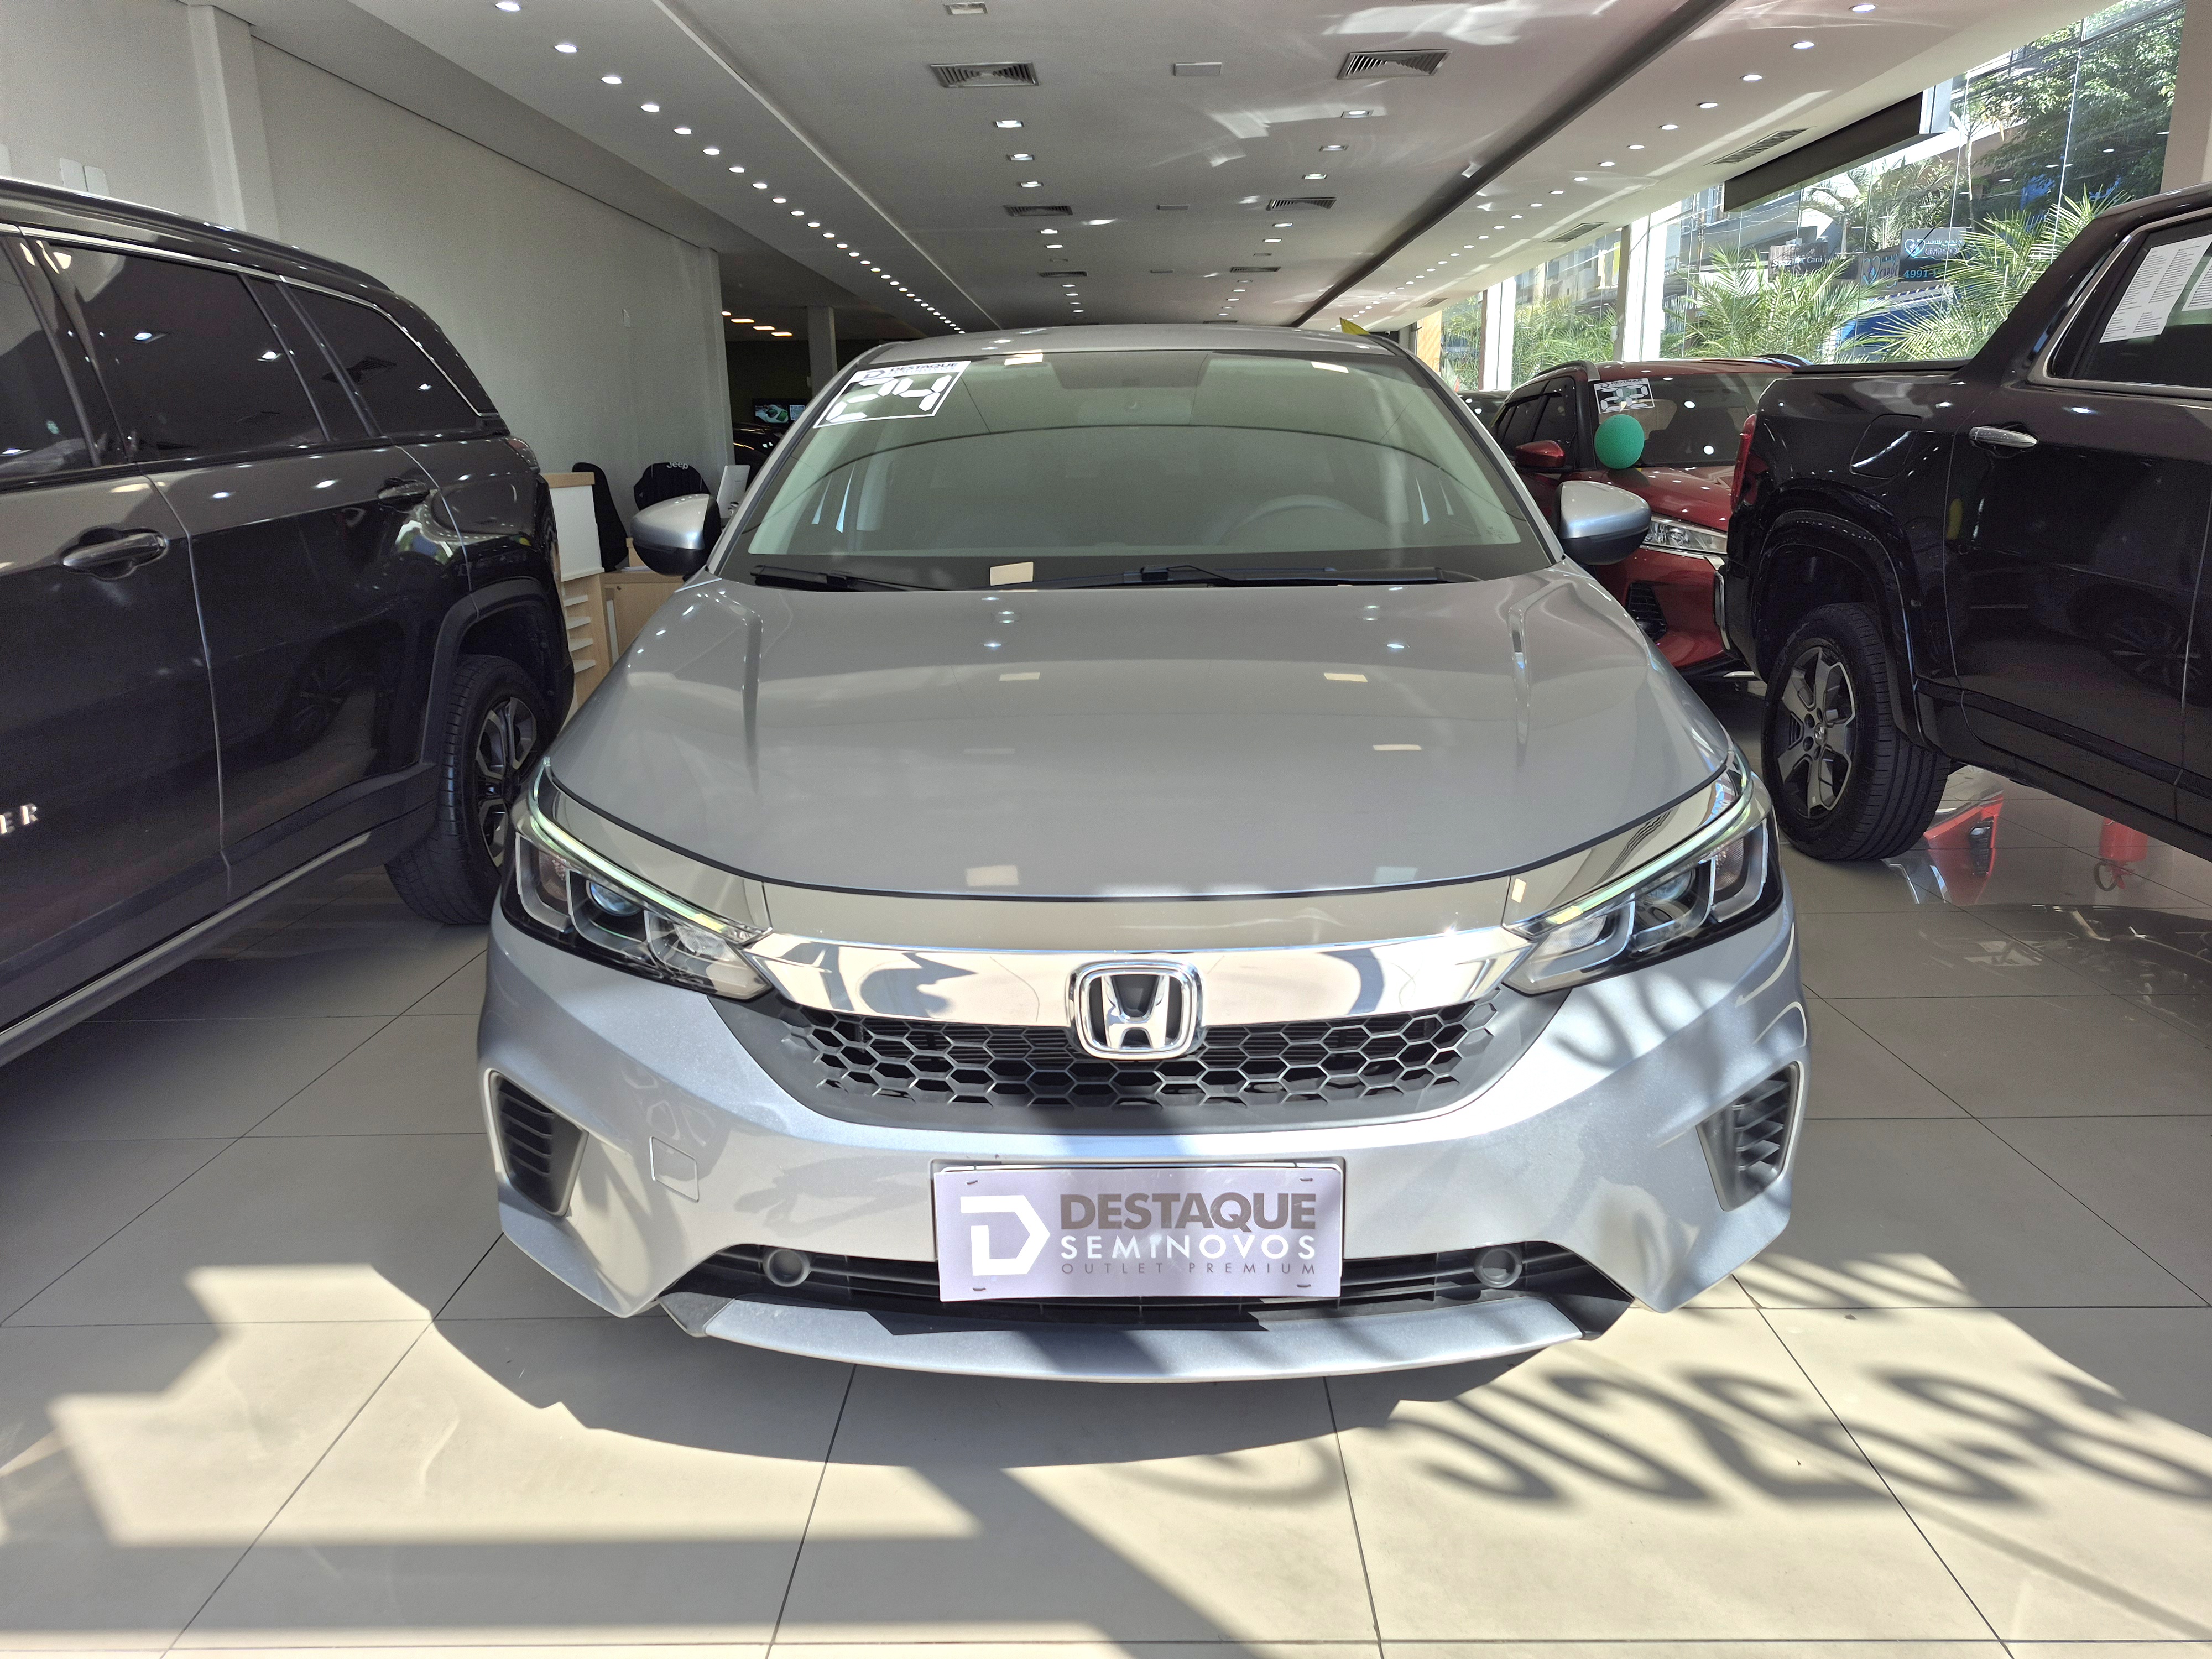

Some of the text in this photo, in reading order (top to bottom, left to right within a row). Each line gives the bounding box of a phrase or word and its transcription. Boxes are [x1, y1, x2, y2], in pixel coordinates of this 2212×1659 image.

[825, 375, 952, 424] 24
[1600, 384, 1649, 411] 22
[666, 461, 689, 470] Jeep
[1060, 1192, 1317, 1233] DESTAQUE
[1061, 1234, 1315, 1260] SEMINOVOS
[1061, 1262, 1316, 1275] OUTLET PREMIUM
